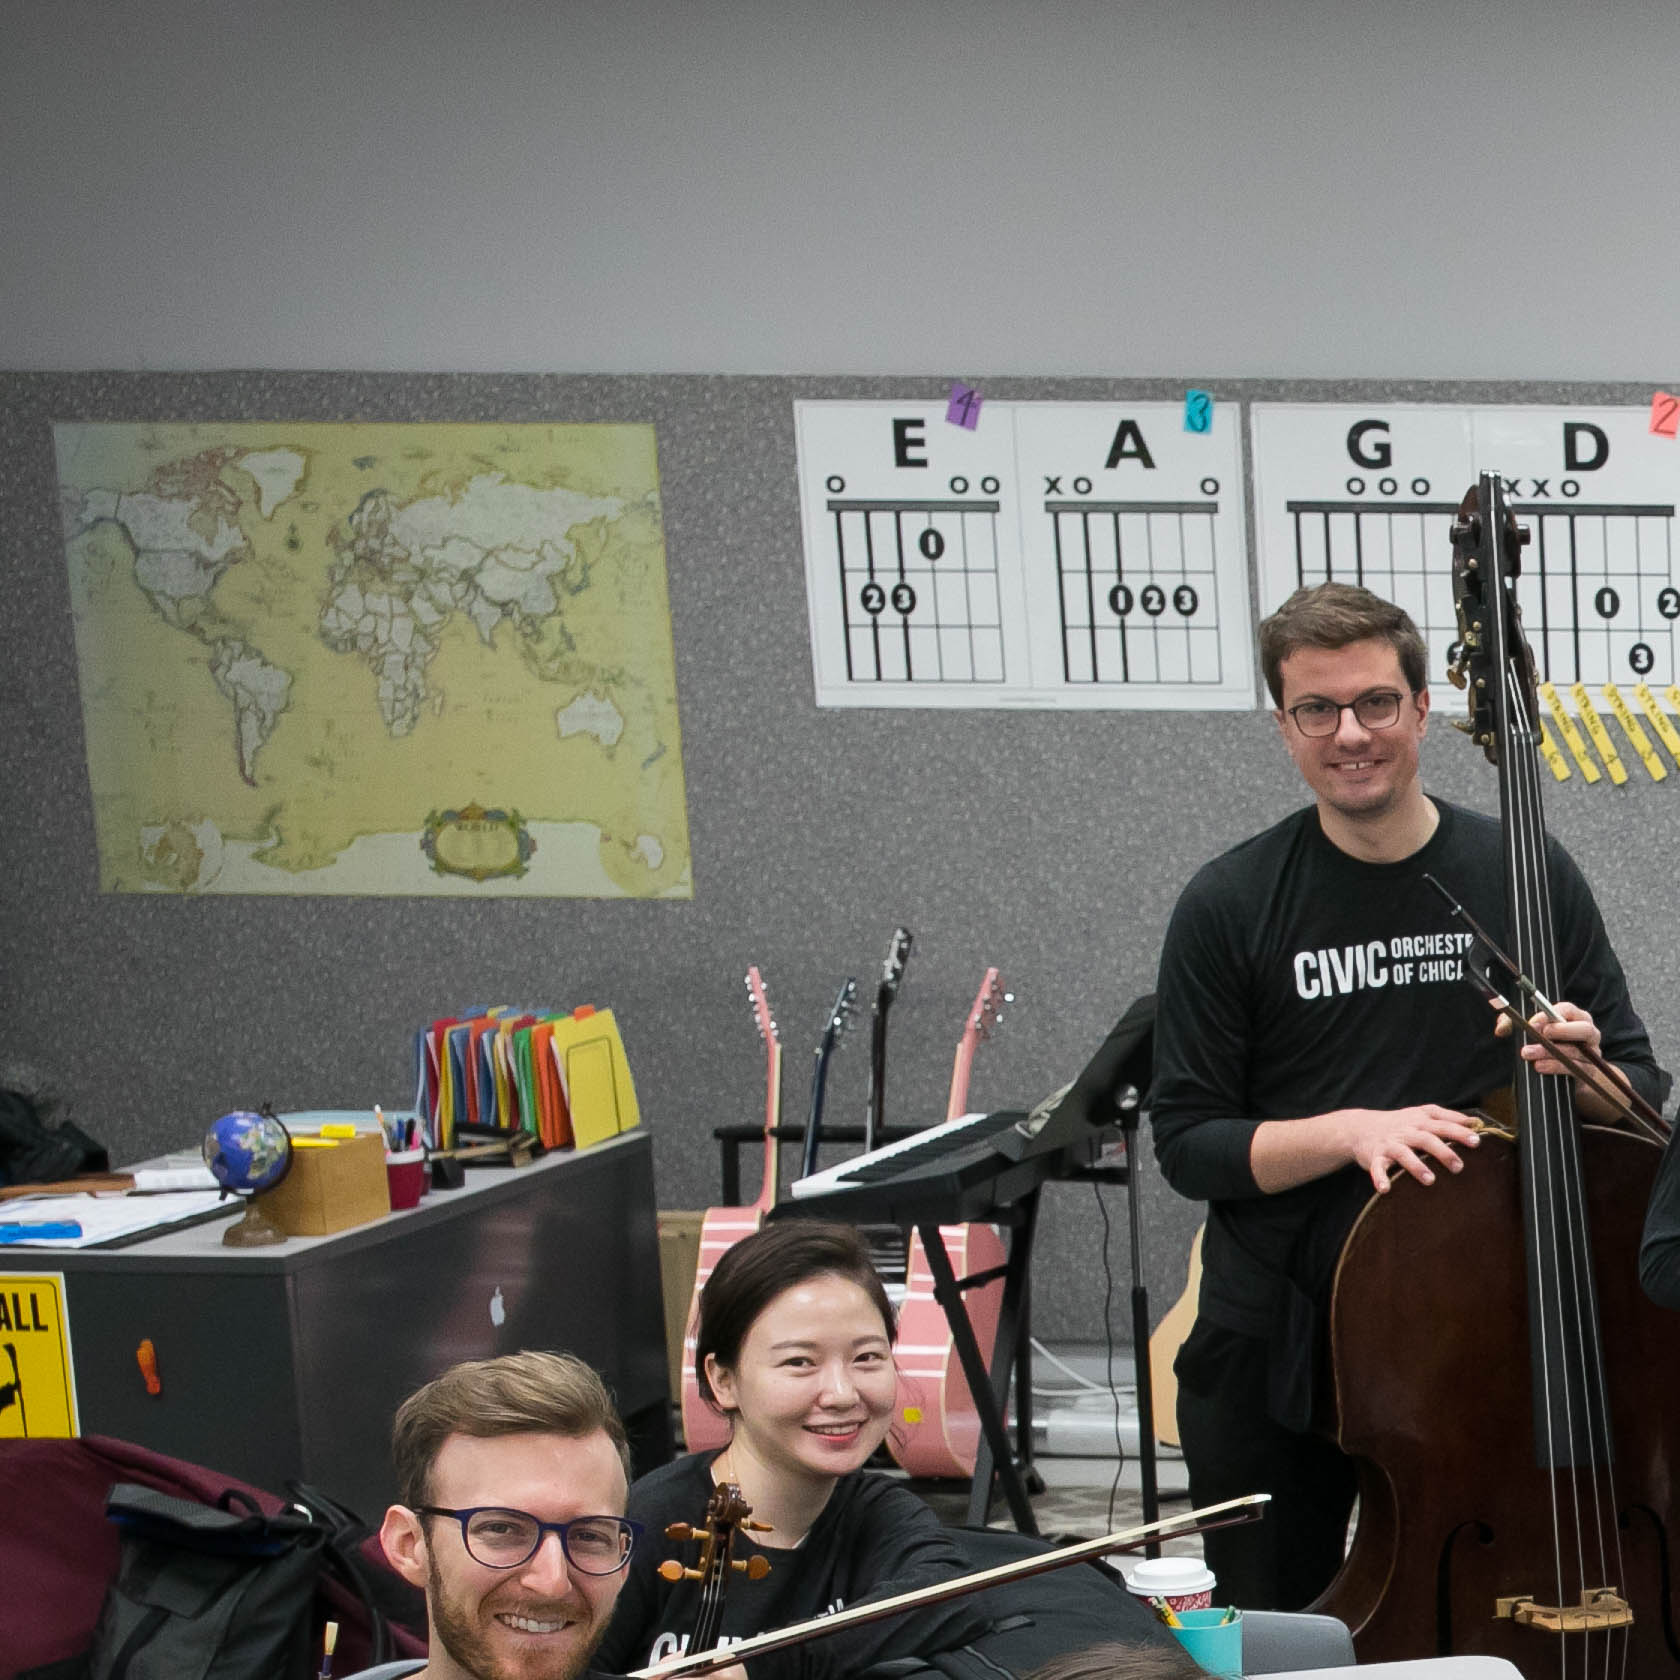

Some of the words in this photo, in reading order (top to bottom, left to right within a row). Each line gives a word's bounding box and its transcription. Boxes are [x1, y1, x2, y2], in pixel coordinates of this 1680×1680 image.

[1653, 397, 1679, 435] 2
[893, 418, 928, 467] E
[1105, 420, 1156, 468] A
[1346, 419, 1392, 469] G
[1563, 422, 1610, 471] D
[1294, 940, 1388, 999] CIVIC
[1391, 933, 1475, 958] ORCHEST
[1393, 963, 1414, 985] OF
[1419, 960, 1463, 983] CHIC
